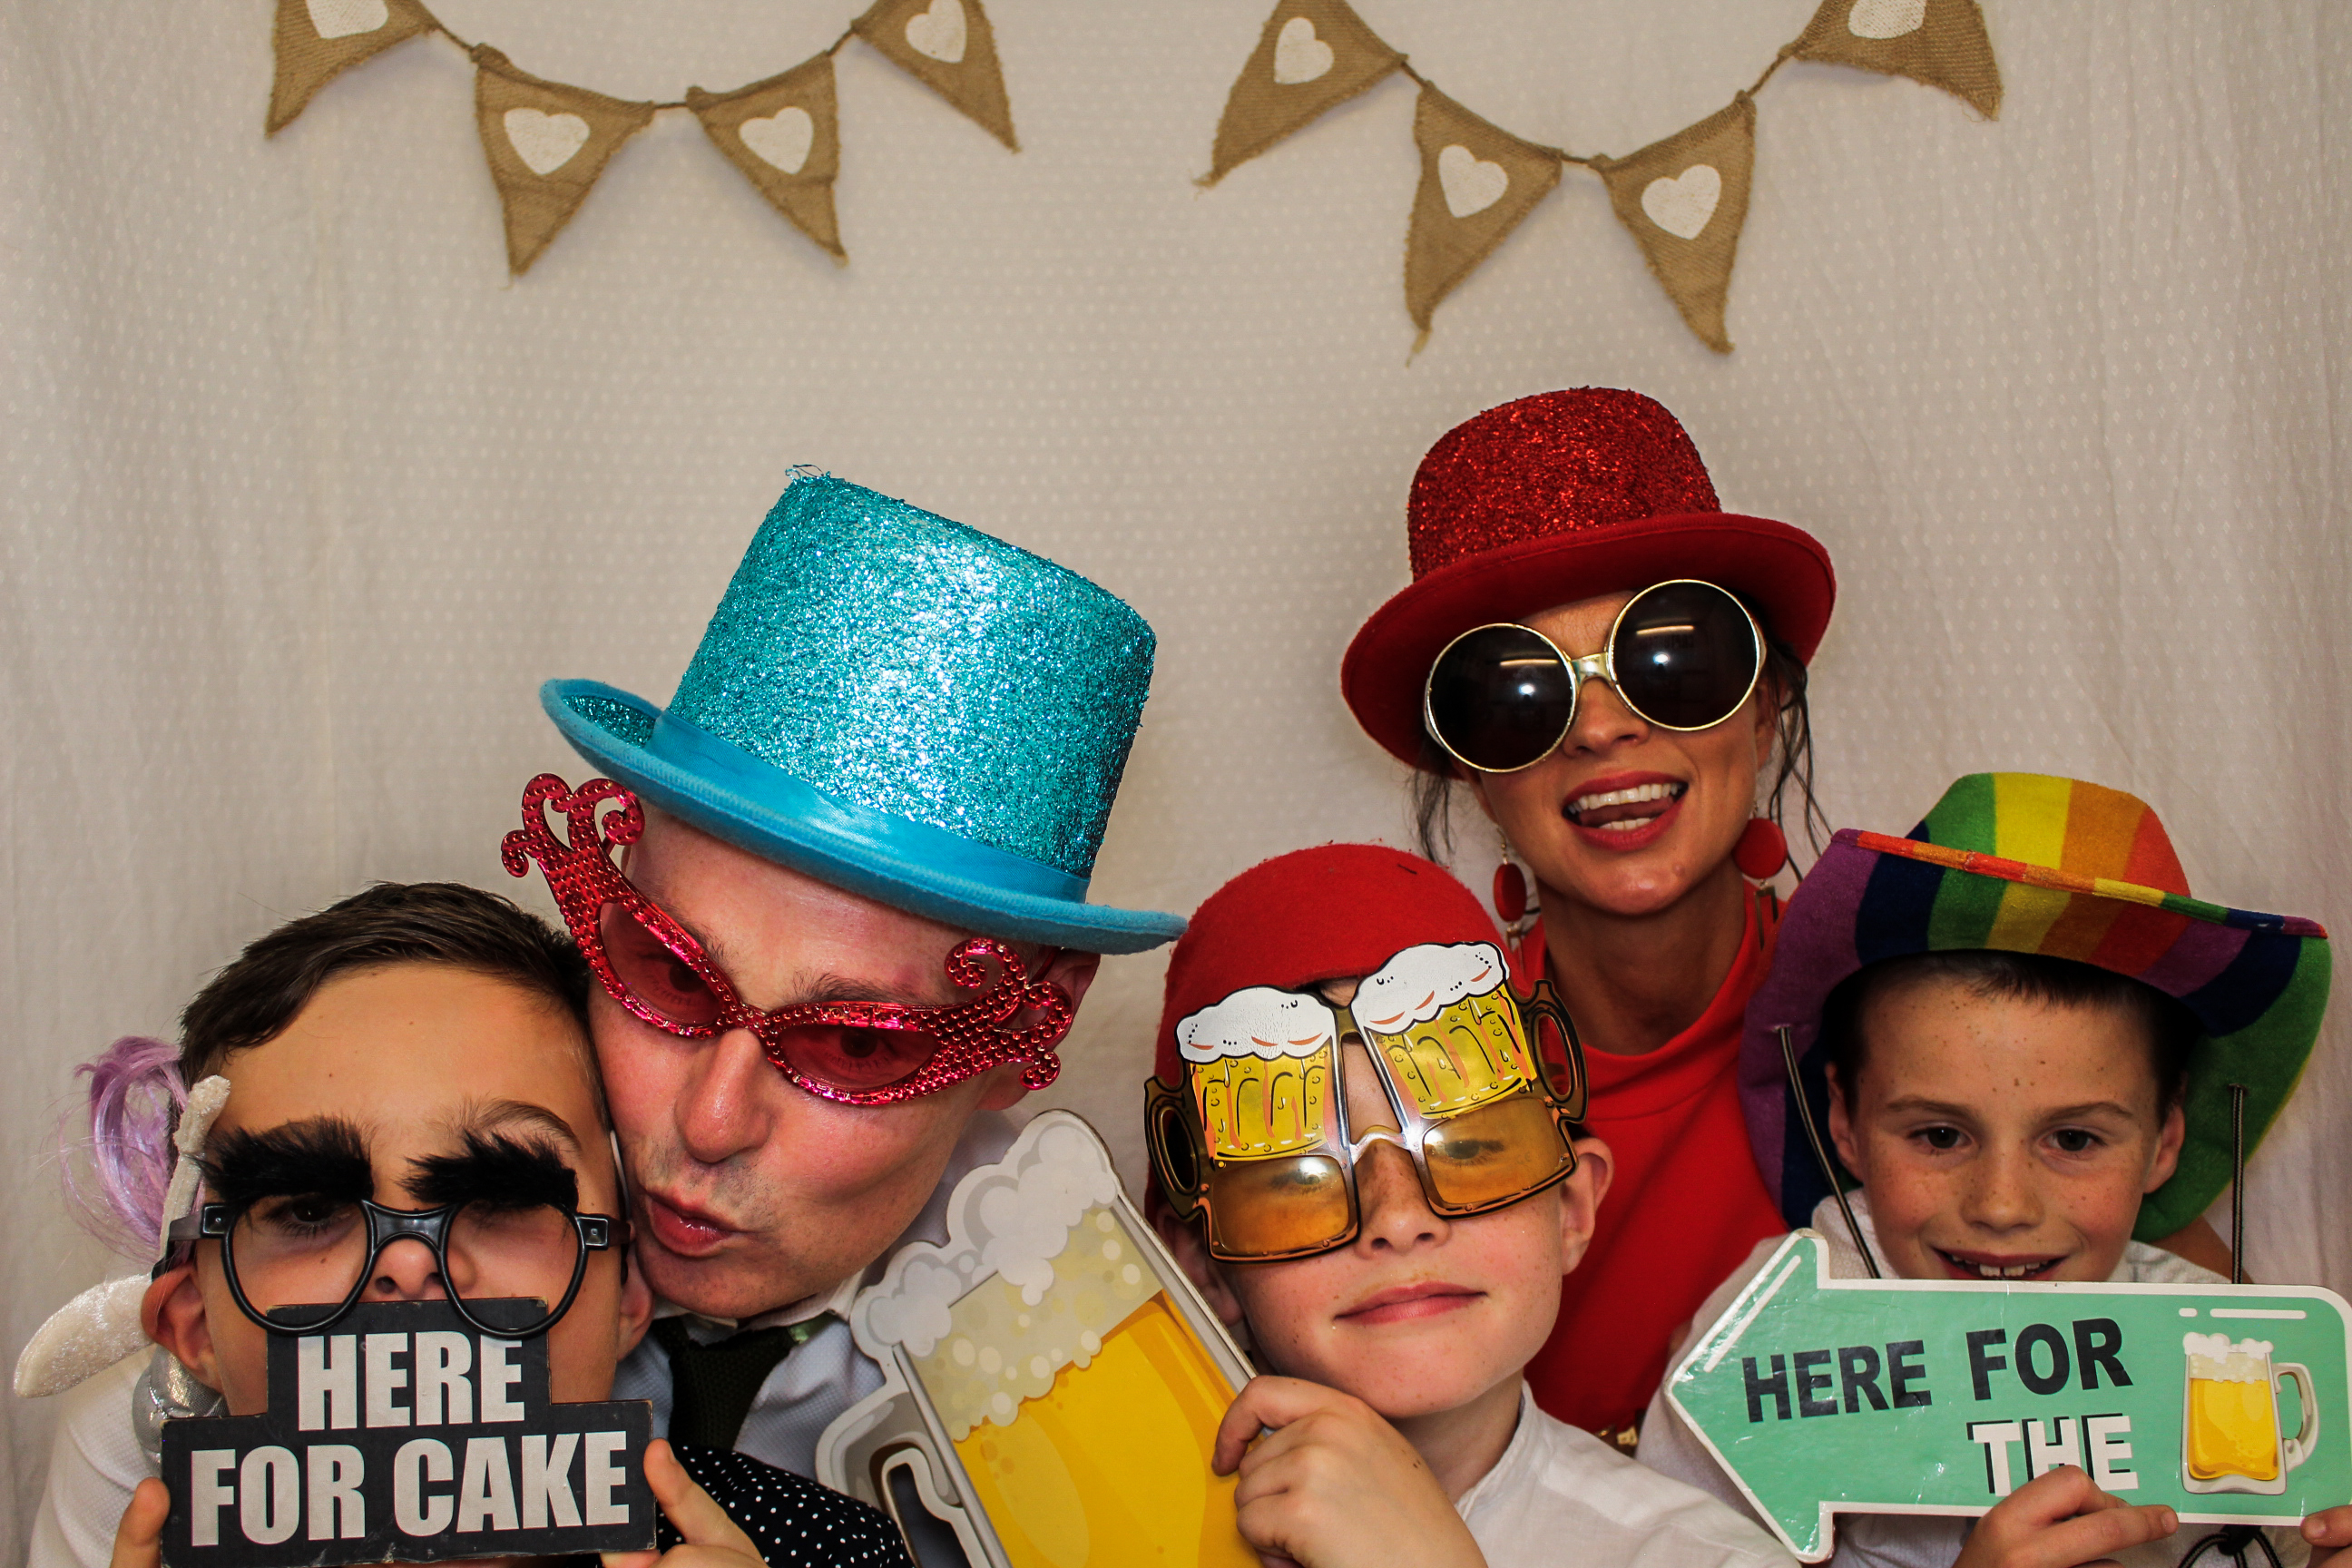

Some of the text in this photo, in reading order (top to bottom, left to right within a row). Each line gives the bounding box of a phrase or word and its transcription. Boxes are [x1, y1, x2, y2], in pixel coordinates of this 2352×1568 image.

[297, 1330, 526, 1432] HERE
[1740, 1317, 2134, 1424] HERE FOR
[191, 1430, 631, 1548] FOR CAKE
[1967, 1413, 2140, 1497] THE
